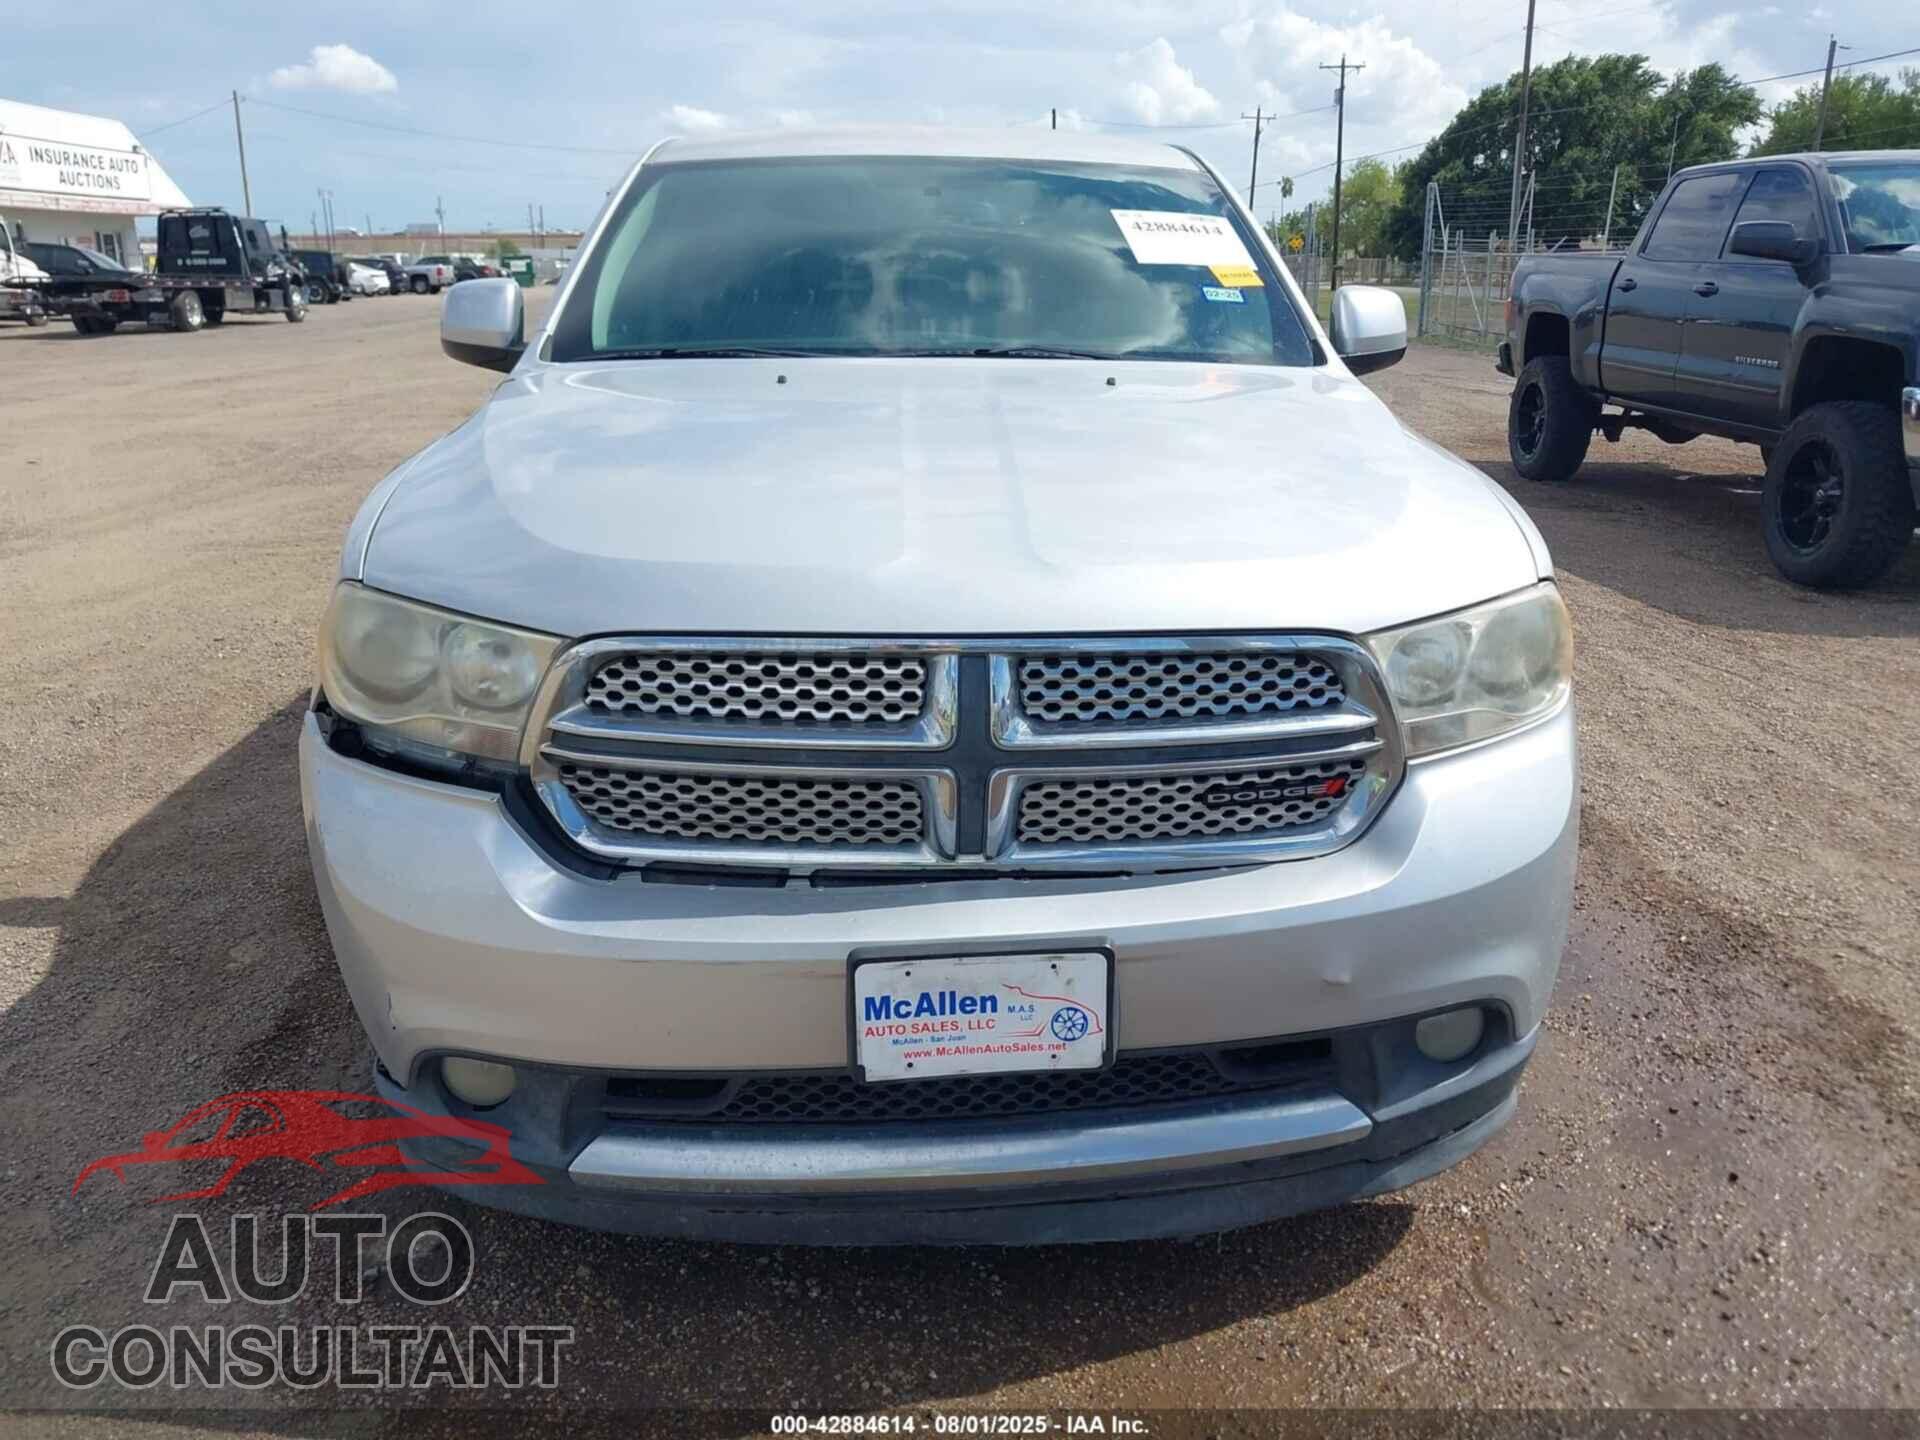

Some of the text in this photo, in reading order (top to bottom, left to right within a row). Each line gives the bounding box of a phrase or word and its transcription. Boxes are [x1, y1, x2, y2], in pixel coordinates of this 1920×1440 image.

[28, 144, 139, 174] INSURANCE AUTO
[58, 169, 121, 191] AUCTIONS
[1207, 785, 1328, 803] DODGE
[864, 991, 998, 1021] McAllen
[864, 1018, 997, 1037] AUTO SALES, LLC
[892, 1037, 924, 1046] McAllen
[931, 1035, 945, 1043] San
[949, 1033, 967, 1042] Juan
[903, 1042, 1068, 1060] www.McAllenAutoSales.net
